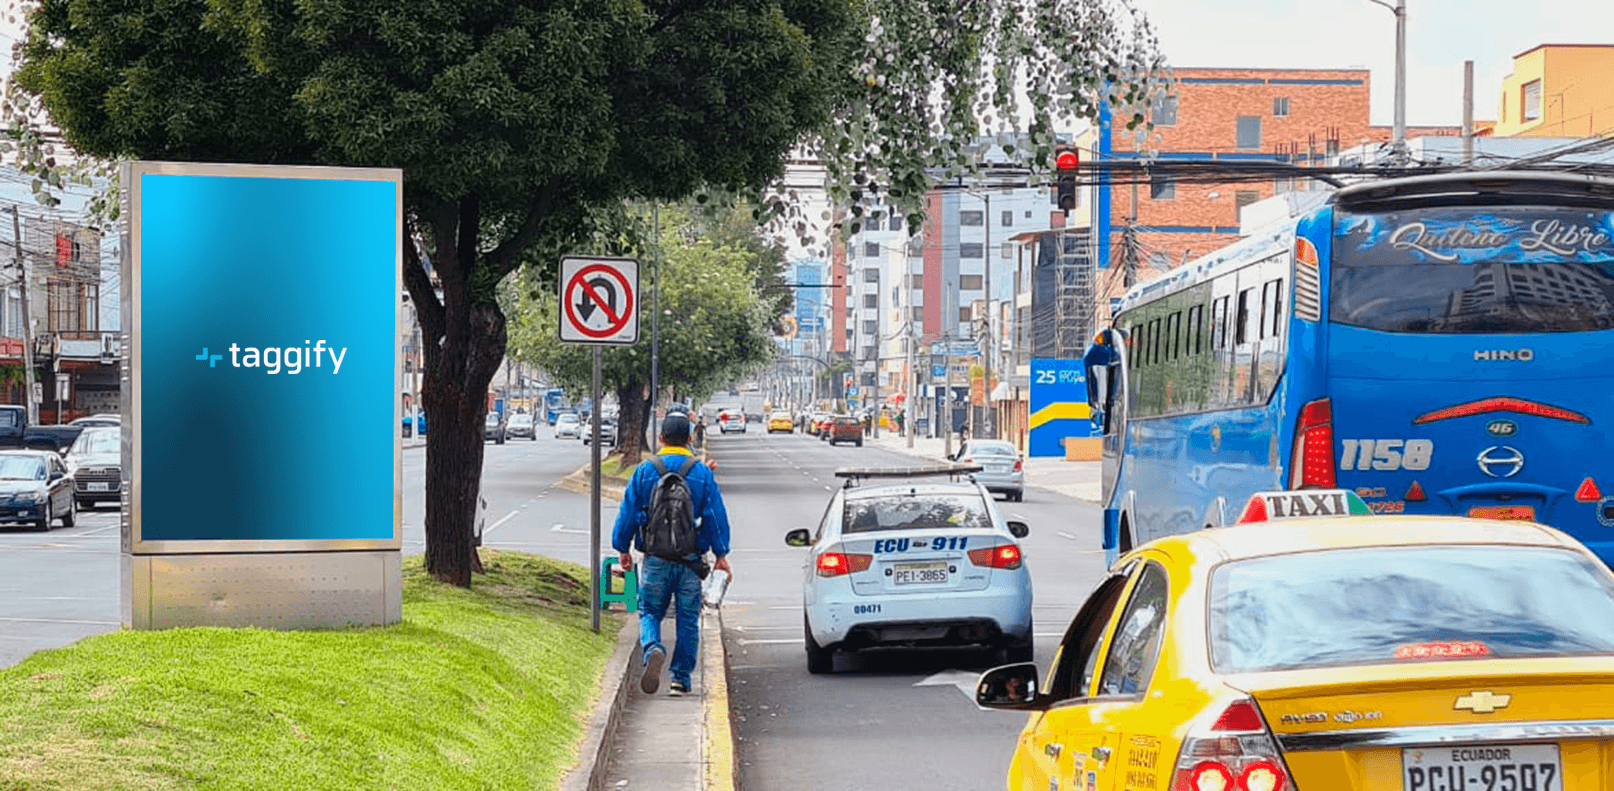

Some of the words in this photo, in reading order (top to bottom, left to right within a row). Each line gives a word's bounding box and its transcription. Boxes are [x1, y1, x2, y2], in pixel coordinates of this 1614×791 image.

[1520, 219, 1610, 255] Libre
[229, 339, 347, 375] taggify
[1474, 349, 1533, 361] HINO
[1036, 370, 1055, 383] 25
[1488, 423, 1513, 434] 46
[1340, 439, 1433, 470] 1158
[1267, 494, 1345, 517] TAXI
[874, 538, 909, 553] ECU
[932, 537, 968, 550] 911
[1451, 749, 1511, 762] ECUADOR
